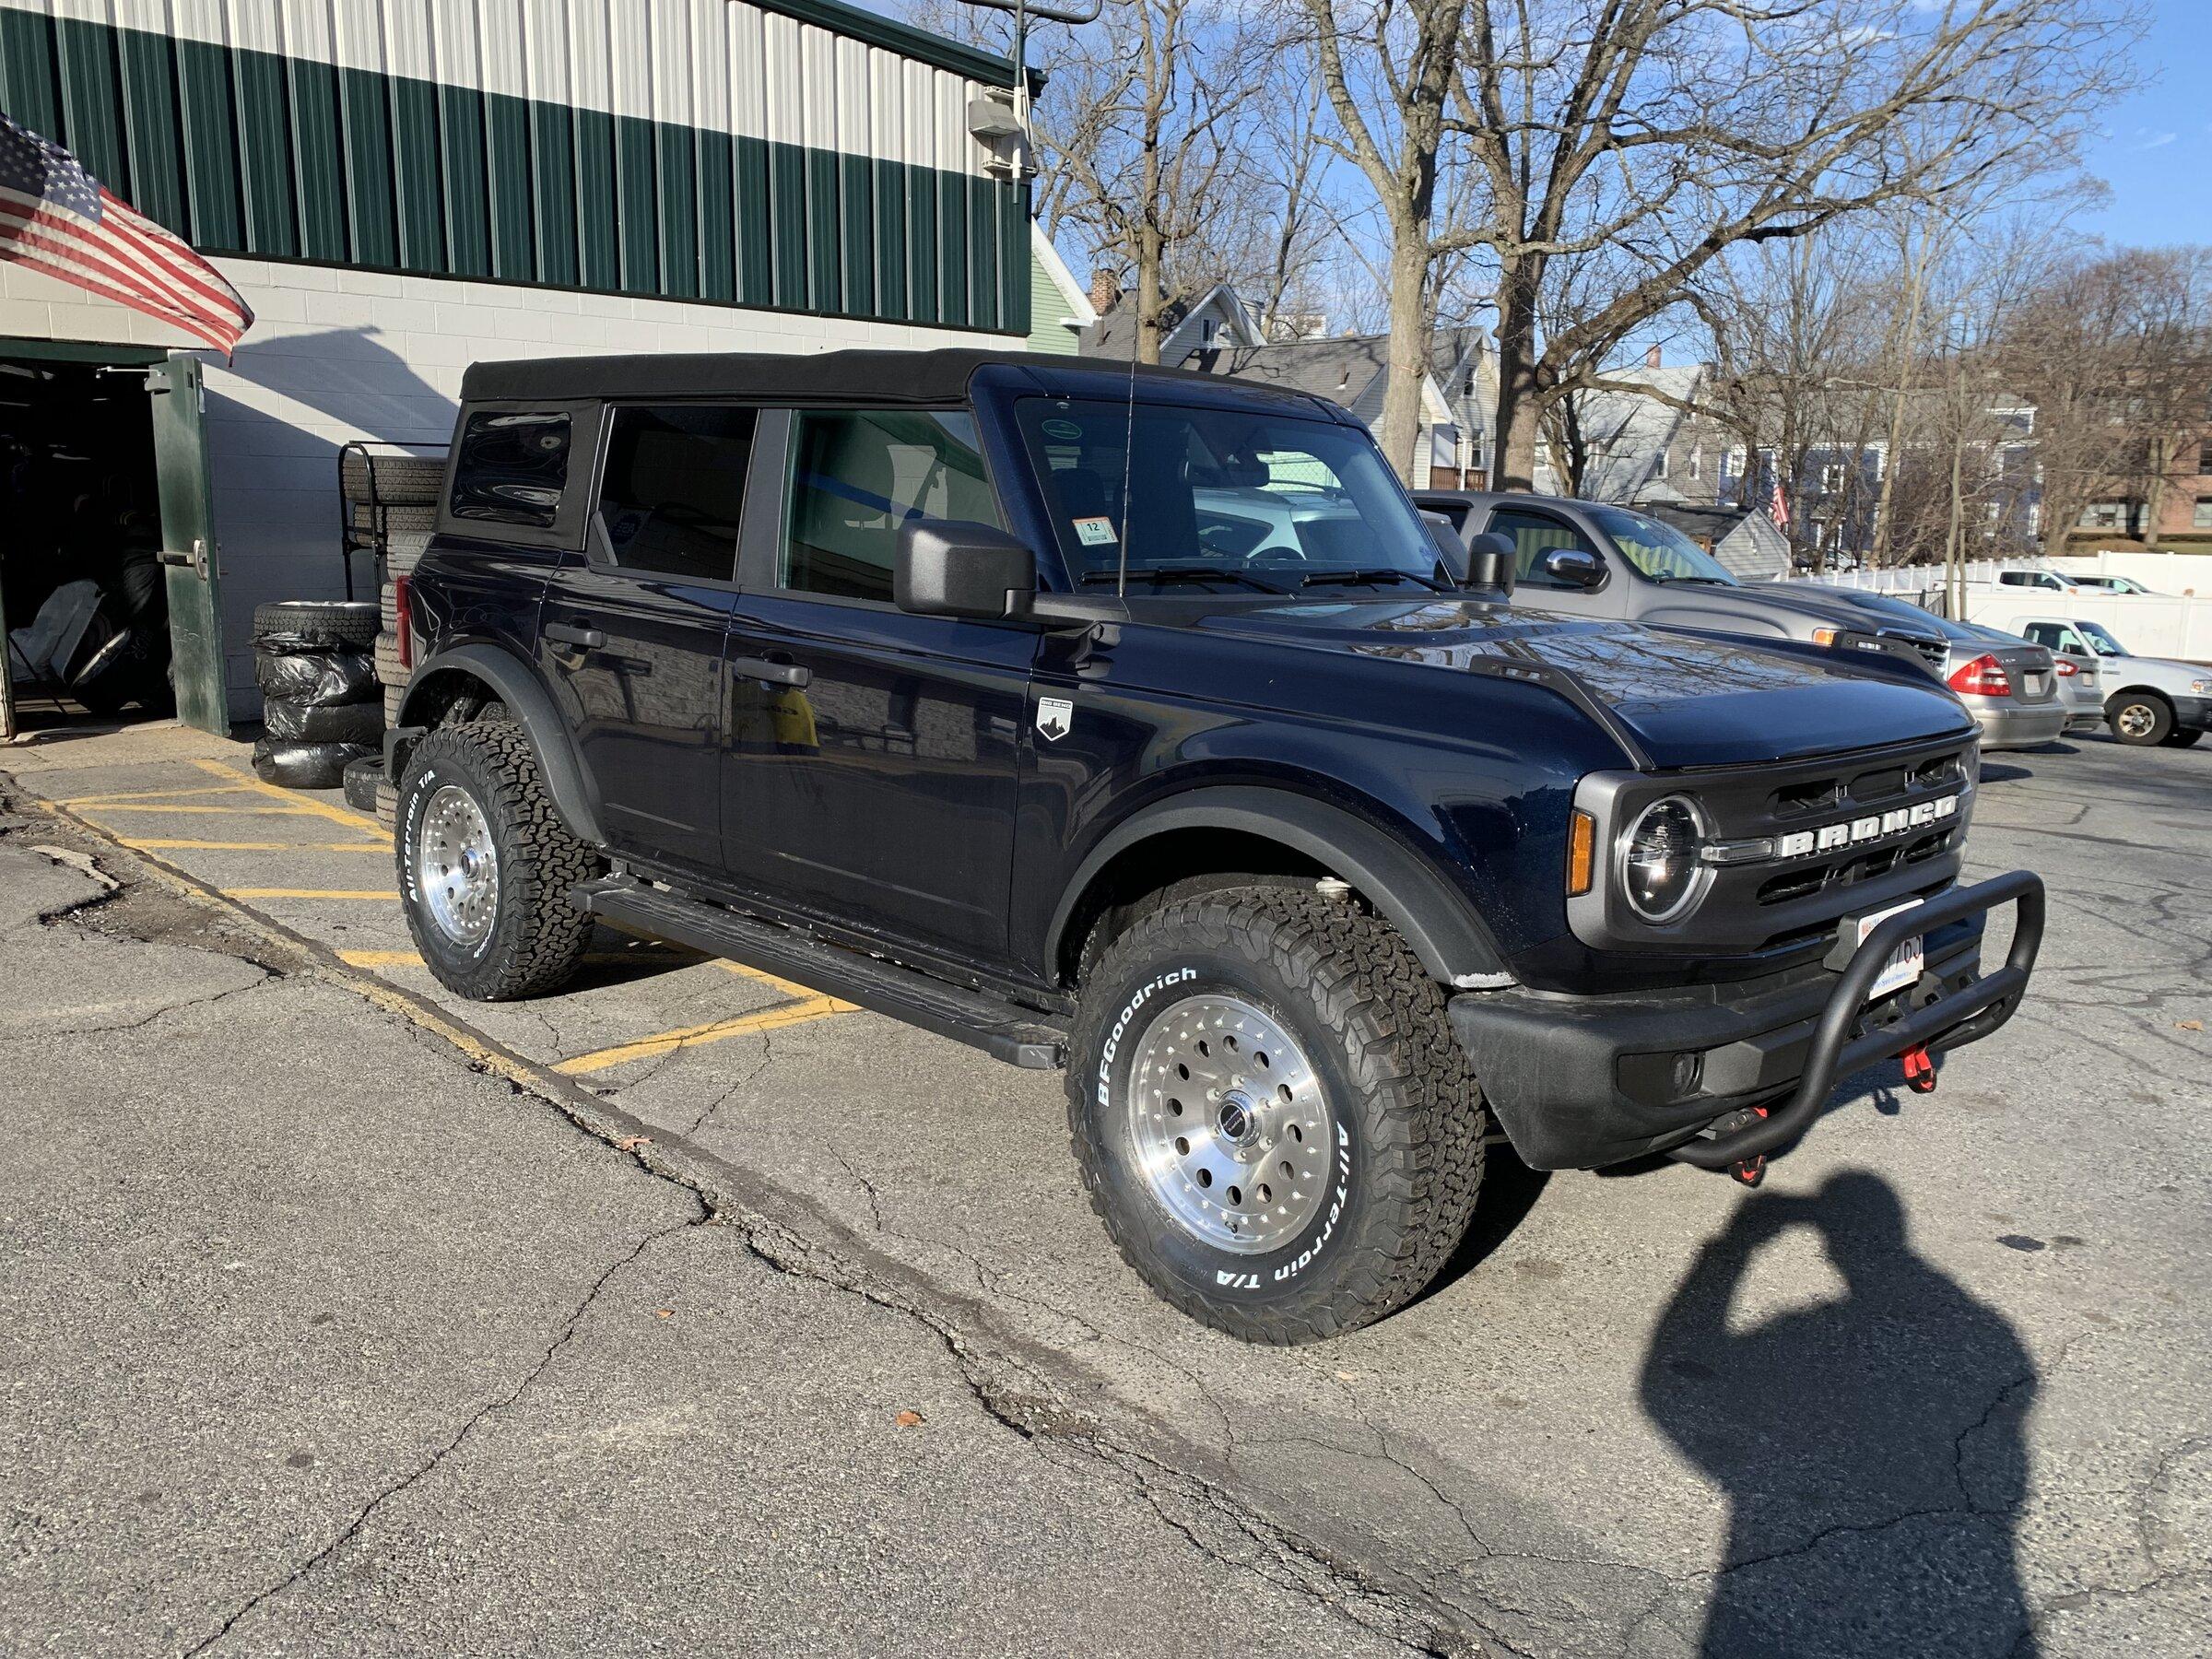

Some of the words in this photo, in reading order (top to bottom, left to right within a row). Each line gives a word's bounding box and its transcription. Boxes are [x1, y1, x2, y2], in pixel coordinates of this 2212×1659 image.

[1087, 522, 1100, 532] 12
[404, 792, 419, 903] All-Terrain
[418, 769, 436, 789] T/A
[1781, 794, 1959, 857] BRONCO
[1097, 967, 1197, 1108] BFGoodrich
[1274, 1120, 1350, 1282] All-Terrain
[1216, 1268, 1262, 1289] T/A
